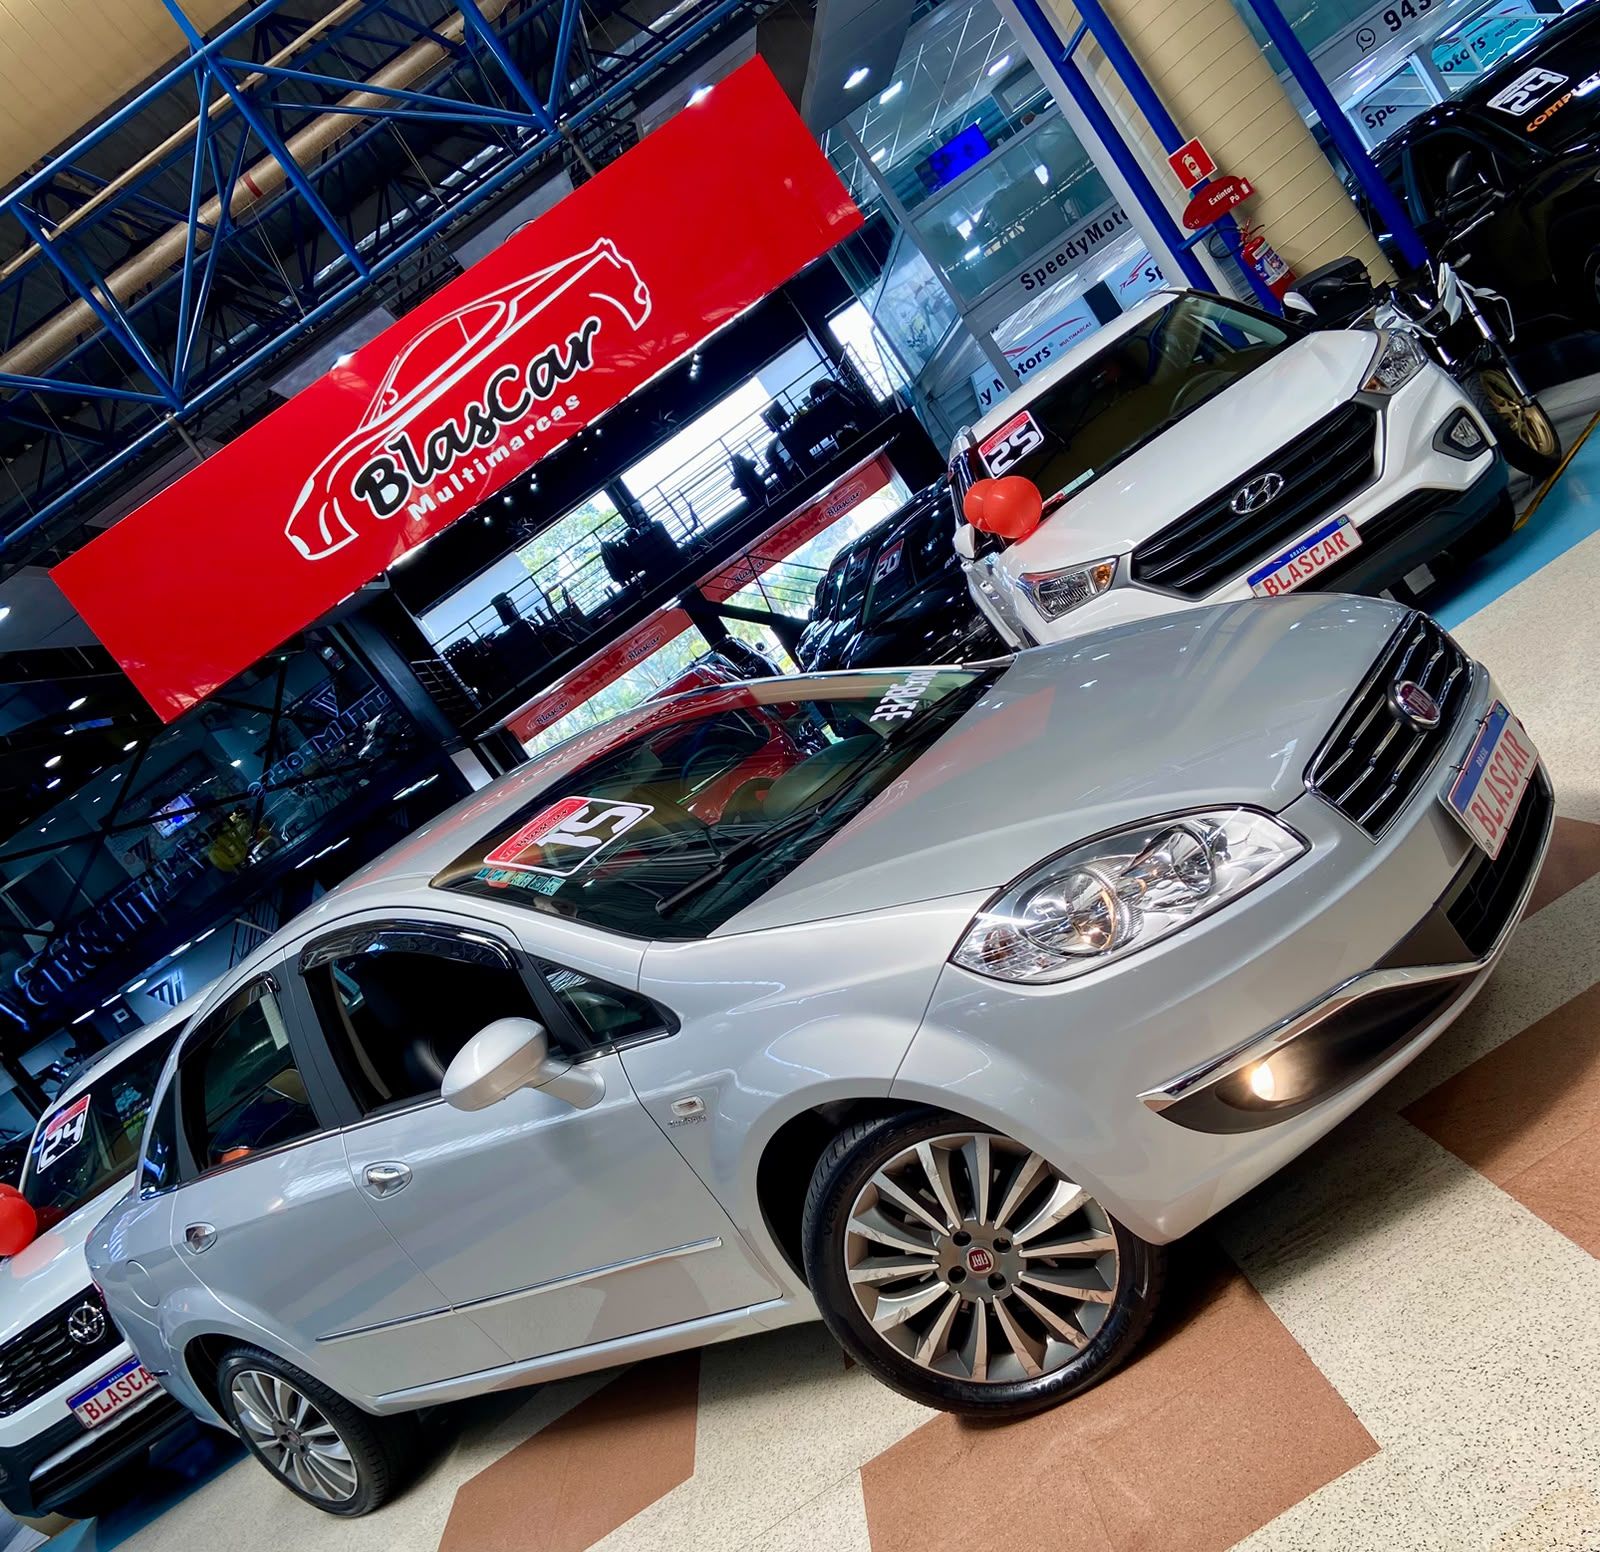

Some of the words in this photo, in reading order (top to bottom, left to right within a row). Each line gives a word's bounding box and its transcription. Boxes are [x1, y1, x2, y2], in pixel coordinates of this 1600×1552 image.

[1502, 73, 1564, 112] 24
[1208, 184, 1235, 206] Extintor
[1229, 194, 1240, 204] Pó
[352, 317, 601, 519] BlasCar
[407, 394, 580, 522] Multimarcas
[990, 423, 1041, 474] 25
[1263, 531, 1350, 597] BLASCAR
[1470, 729, 1530, 840] BLASCAR
[537, 805, 644, 848] 15
[41, 1112, 84, 1168] 24
